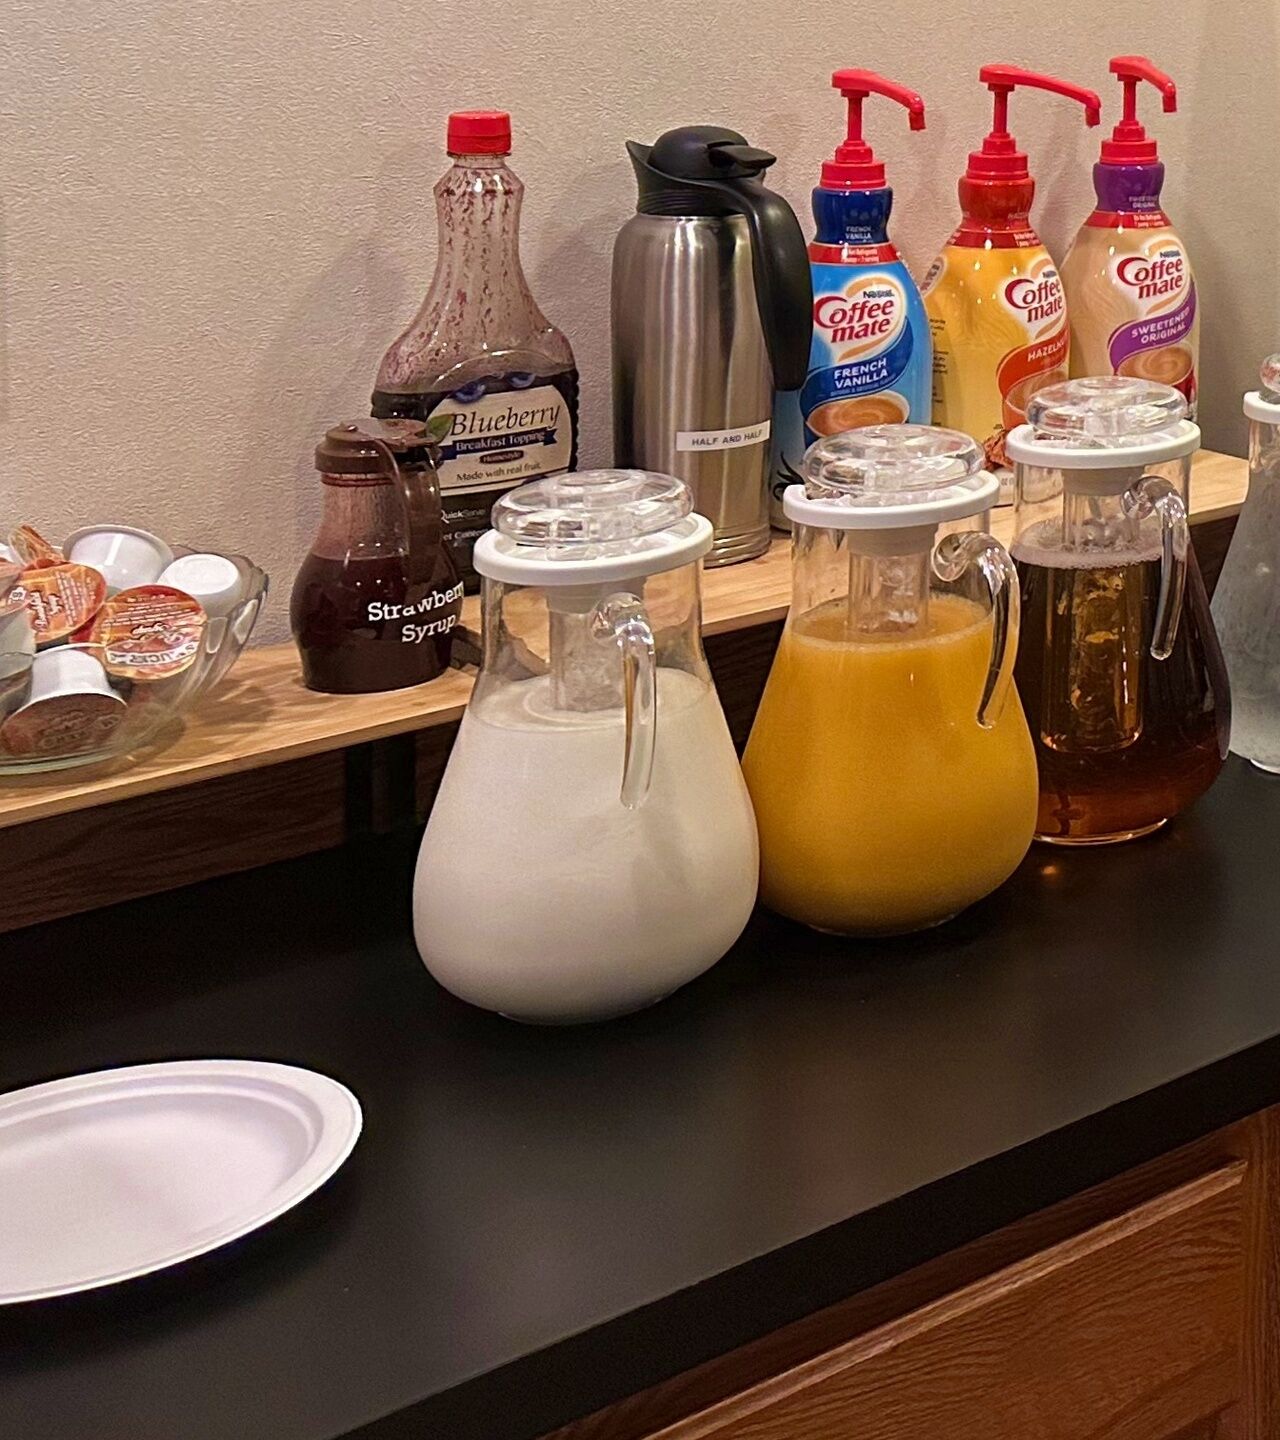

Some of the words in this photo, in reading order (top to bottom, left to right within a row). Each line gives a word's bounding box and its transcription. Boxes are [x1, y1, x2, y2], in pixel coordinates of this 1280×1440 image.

[1116, 257, 1183, 286] Coffee
[1137, 273, 1183, 300] mate
[813, 295, 895, 329] Coffee
[1131, 307, 1190, 338] SWEETENED
[830, 317, 892, 344] mate
[1140, 322, 1187, 344] ORIGINAL
[833, 357, 887, 380] FRENCH
[834, 368, 889, 389] VANILLA
[449, 404, 562, 438] Blueberry
[456, 435, 507, 452] Breakfast
[508, 430, 546, 446] Topping
[691, 436, 719, 447] HALF
[721, 434, 741, 444] AND
[743, 428, 763, 442] HALF
[456, 470, 485, 482] Made
[485, 466, 506, 478] with
[506, 464, 523, 475] real
[401, 614, 457, 646] Syrup
